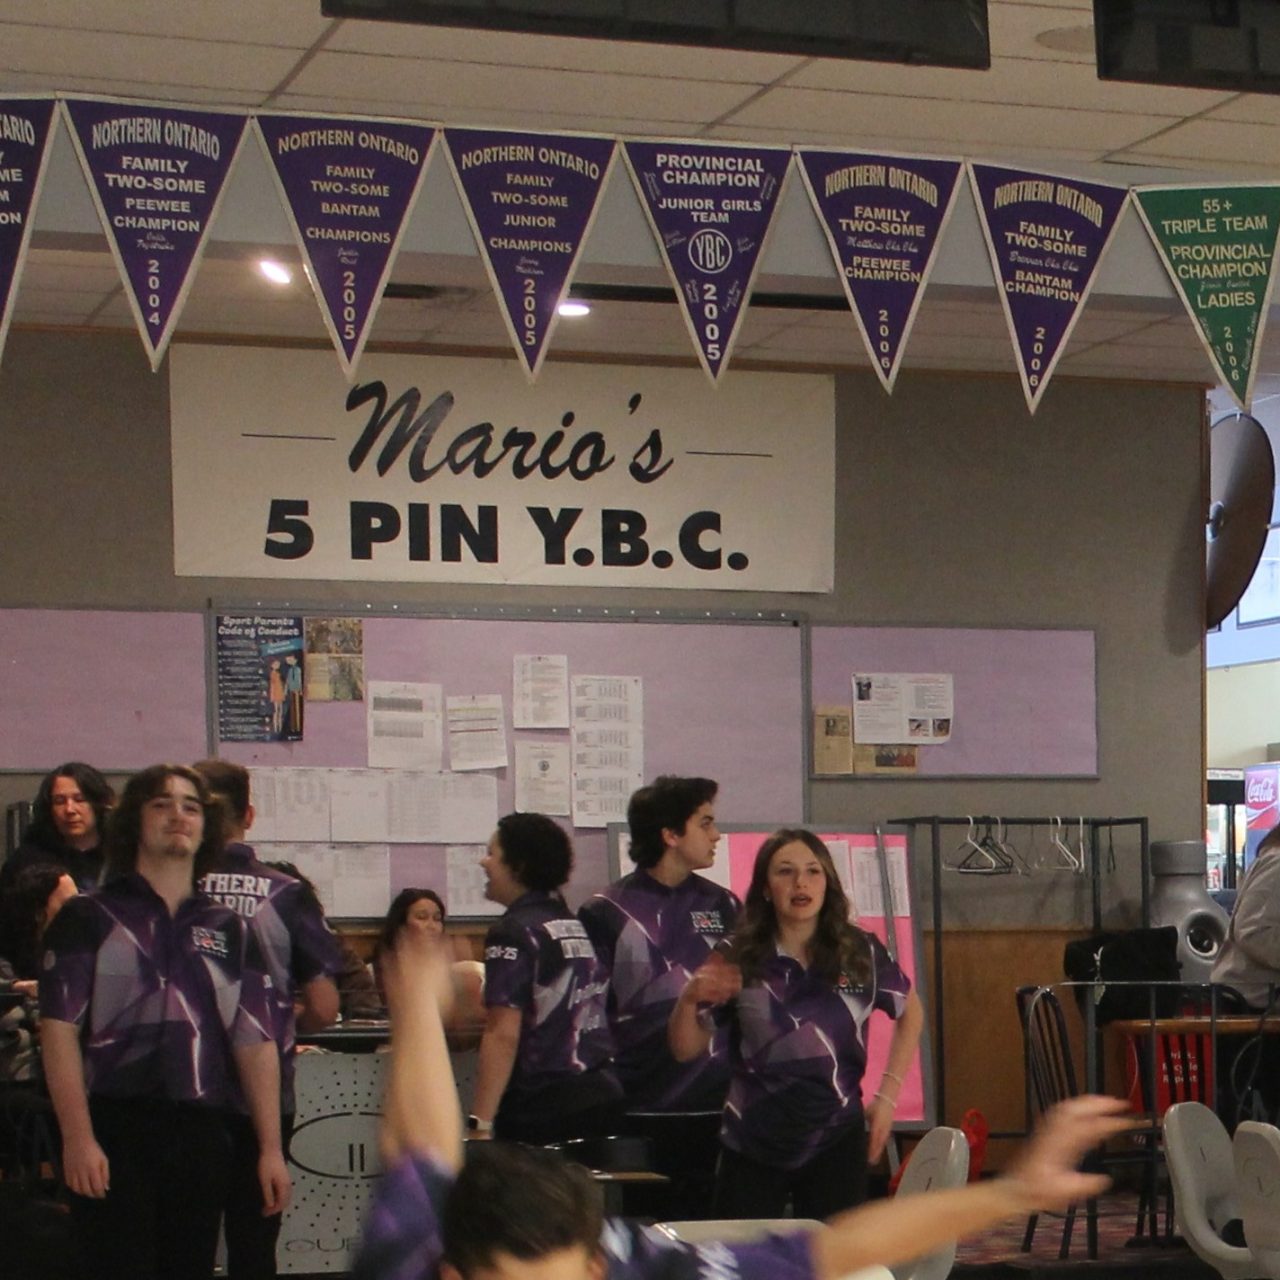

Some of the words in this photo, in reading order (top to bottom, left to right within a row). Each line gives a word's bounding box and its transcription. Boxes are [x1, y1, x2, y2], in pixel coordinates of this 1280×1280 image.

[93, 117, 161, 150] NORTHERN
[165, 119, 219, 161] ONTARIO
[278, 129, 354, 154] NORTHERN
[358, 133, 419, 165] ONTARIO
[122, 156, 189, 174] FAMILY
[462, 146, 534, 170] NORTHERN
[538, 148, 599, 180] ONTARIO
[656, 154, 764, 172] PROVINCIAL
[326, 165, 375, 180] FAMILY
[506, 173, 554, 187] FAMILY
[663, 171, 760, 187] CHAMPION
[105, 173, 207, 194] TWO-SOME
[310, 180, 390, 197] TWO-SOME
[825, 165, 885, 197] NORTHERN
[889, 167, 937, 207] ONTARIO
[126, 198, 190, 213] PEEWEE
[491, 192, 569, 207] TWO-SOME
[659, 198, 714, 210] JUNIOR
[722, 200, 762, 211] GIRLS
[994, 180, 1051, 209] NORTHERN
[1056, 185, 1103, 228] ONTARIO
[321, 203, 380, 218] BANTAM
[691, 212, 729, 223] TEAM
[854, 206, 911, 222] FAMILY
[114, 216, 200, 233] CHAMPION
[504, 215, 556, 228] JUNIOR
[839, 219, 925, 237] TWO-SOME
[1162, 218, 1216, 234] TRIPLE
[1222, 216, 1268, 231] TEAM
[306, 227, 391, 243] CHAMPIONS
[1020, 221, 1074, 241] FAMILY
[490, 237, 572, 253] CHAMPIONS
[696, 235, 725, 269] YBC
[1004, 232, 1087, 258] TWO-SOME
[1170, 243, 1271, 261] PROVINCIAL
[853, 256, 911, 271] PEEWEE
[1178, 262, 1267, 279] CHAMPION
[845, 267, 921, 283] CHAMPION
[1015, 270, 1073, 290] BANTAM
[148, 260, 160, 325] 2004
[1005, 281, 1082, 304] CHAMPION
[1198, 292, 1256, 308] LADIES
[343, 271, 355, 339] 2005
[524, 279, 536, 345] 2005
[703, 284, 721, 360] 2005
[879, 310, 890, 368] 2006
[1029, 327, 1045, 387] 2006
[1224, 327, 1239, 381] 2006
[345, 379, 674, 483] Mario's
[264, 497, 314, 560] 5
[349, 501, 500, 563] PIN
[525, 506, 749, 570] Y.B.C.
[223, 616, 251, 626] Sport
[254, 617, 294, 626] Parents
[218, 626, 242, 635] Code
[244, 628, 255, 638] of
[258, 627, 299, 636] Conduct
